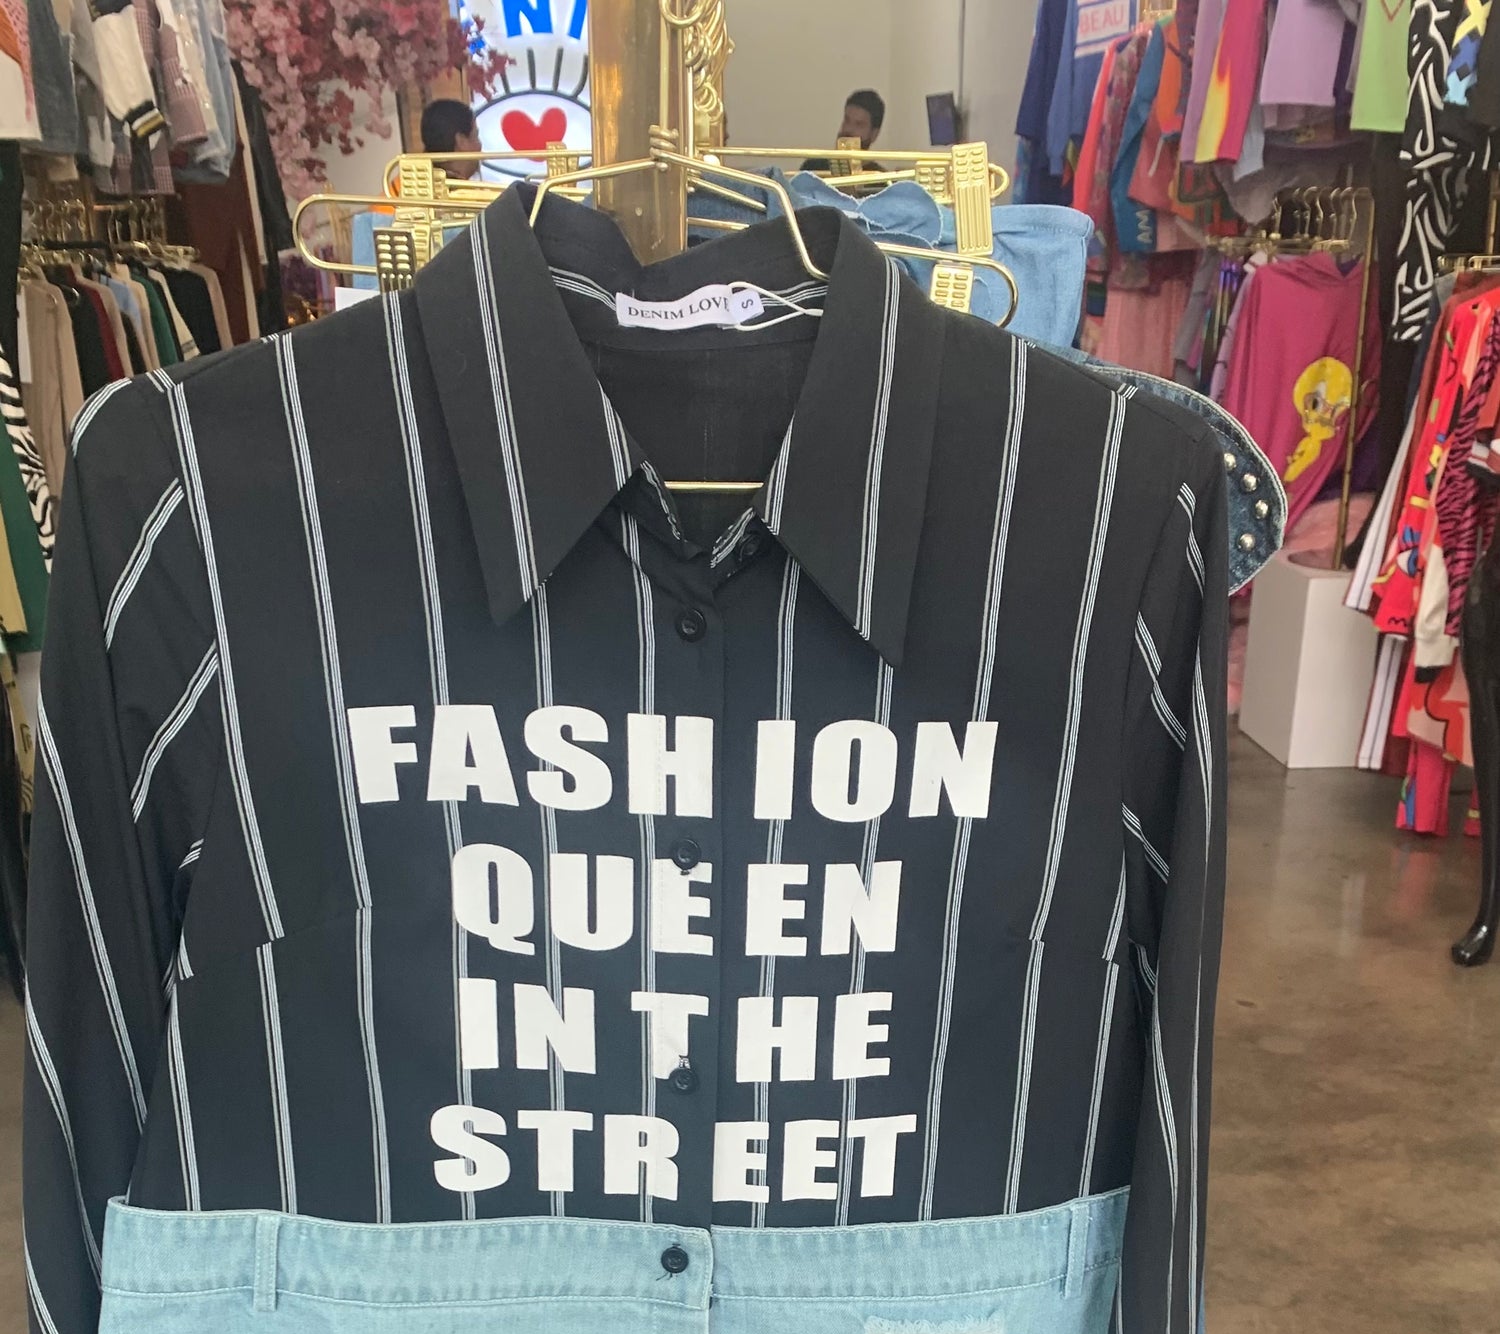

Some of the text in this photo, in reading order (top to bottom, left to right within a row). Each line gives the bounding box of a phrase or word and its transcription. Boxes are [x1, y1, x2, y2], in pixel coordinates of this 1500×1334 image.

[628, 306, 684, 320] DENIM
[741, 299, 754, 310] S
[347, 704, 999, 823] FASHION
[452, 843, 902, 956] QUEEN
[458, 977, 893, 1083] IN THE
[429, 1104, 917, 1203] STREET
